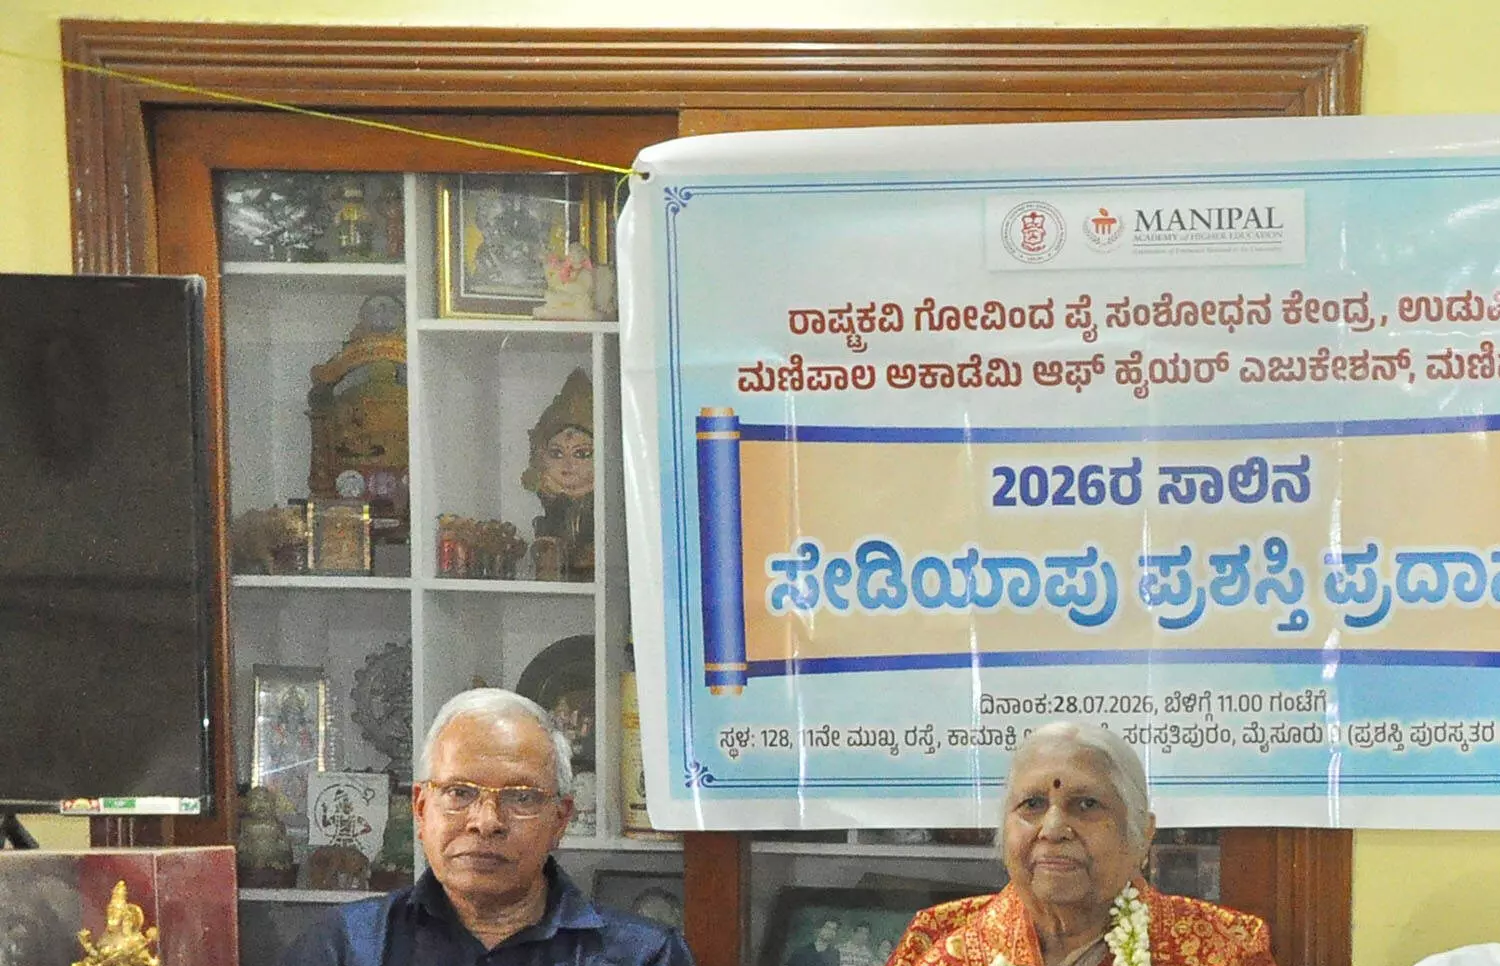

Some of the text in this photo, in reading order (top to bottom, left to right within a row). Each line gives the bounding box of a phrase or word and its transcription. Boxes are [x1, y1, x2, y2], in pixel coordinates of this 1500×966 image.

[1134, 206, 1284, 231] MANIPAL
[788, 301, 903, 353] ರಾಷ್ಟ್ರಕವಿ
[913, 297, 1054, 333] ಗೋವಿಂದ
[1064, 294, 1098, 342] ಪೈ
[1105, 293, 1272, 334] ಸಂಶೋಧನ
[737, 354, 876, 392] ಮಣಿಪಾಲ
[886, 354, 1023, 390] ಅಕಾಡೆಮಿ
[1032, 353, 1105, 392] ಆಫ್
[1114, 350, 1229, 399] ಹೈಯರ್
[1239, 346, 1416, 384] ಎಜುಕೇಶನ್,
[991, 454, 1311, 507] 2026ರ ಸಾಲಿನ
[770, 540, 1119, 627] ಸೇಡಿಯಾಪು
[1137, 536, 1310, 632] ಪ್ರಶಸ್ತಿ
[1164, 690, 1215, 722] ಬೆಳಿಗ್ಗೆ
[1218, 693, 1263, 713] 11.00
[1269, 689, 1327, 712] ಗಂಟೆಗೆ
[719, 726, 755, 759] ಸ್ಥಳ:
[760, 729, 793, 749] 128,
[847, 728, 900, 756] ಮುಖ್ಯ
[904, 724, 941, 754] ರಸ್ತೆ,
[1122, 723, 1236, 755] ಸರಸ್ವತಿಪುರಂ,
[1242, 720, 1323, 754] ಮೈಸೂರು
[1348, 722, 1405, 752] (ಪ್ರಶಸ್ತಿ
